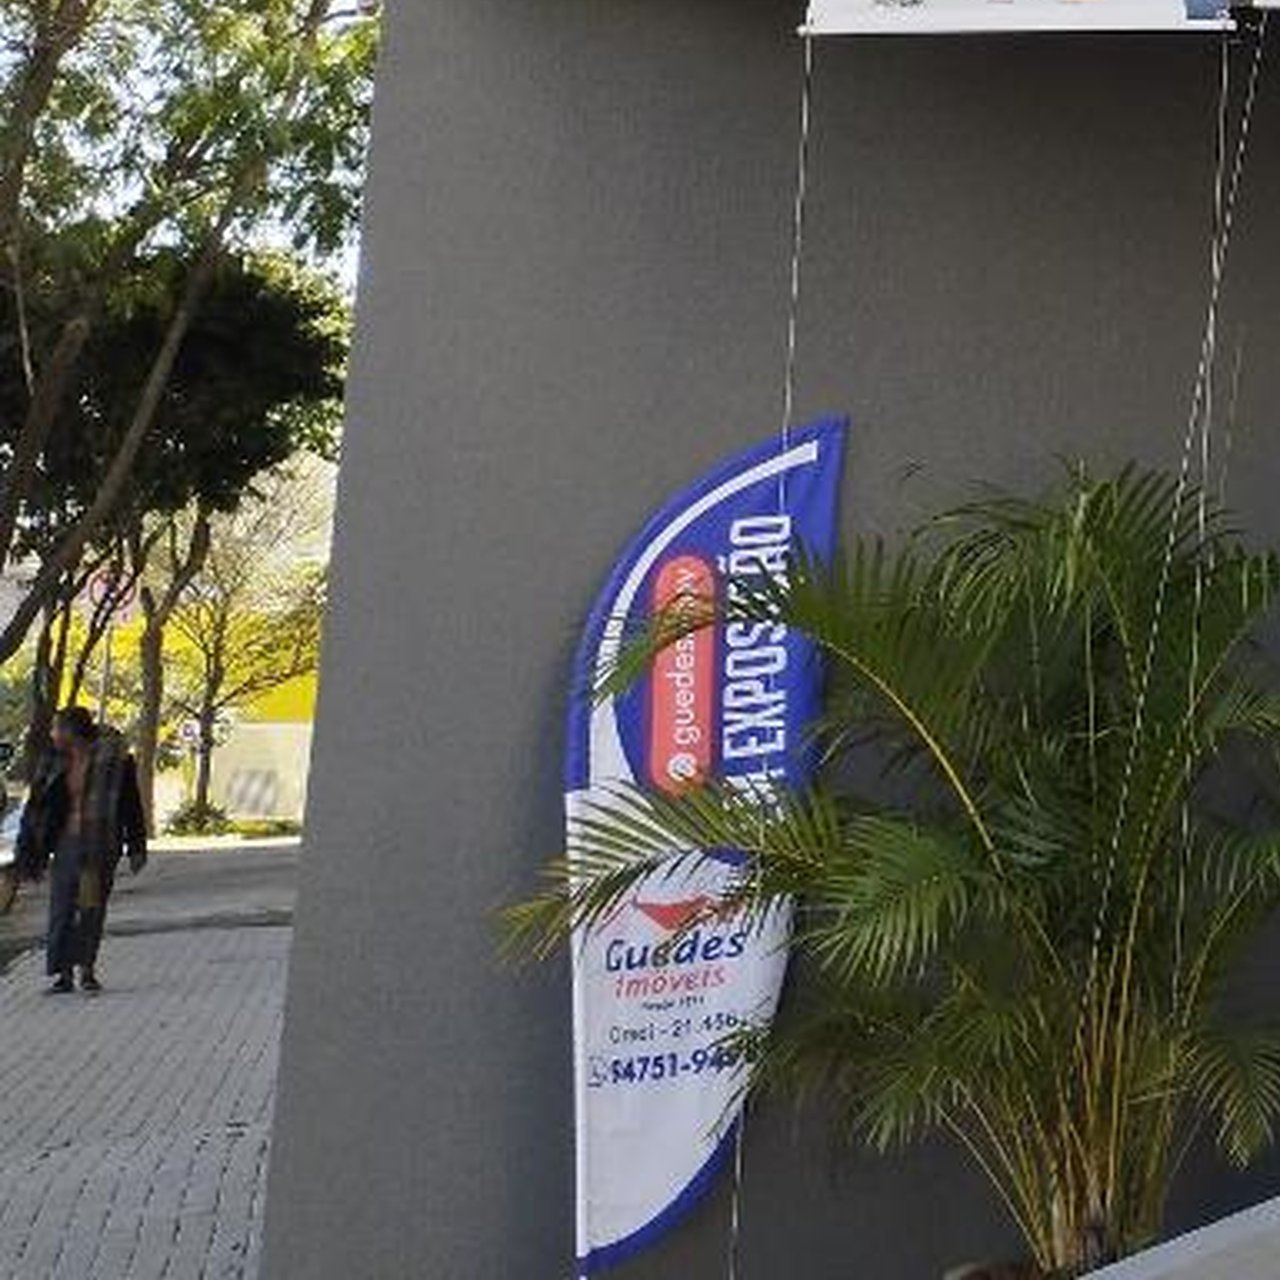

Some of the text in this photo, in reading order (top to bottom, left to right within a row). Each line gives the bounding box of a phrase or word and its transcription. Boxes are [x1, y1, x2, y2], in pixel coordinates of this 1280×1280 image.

[718, 515, 791, 759] EXPOSÃO
[607, 931, 745, 971] Guedes
[611, 1044, 757, 1084] 94751-94
